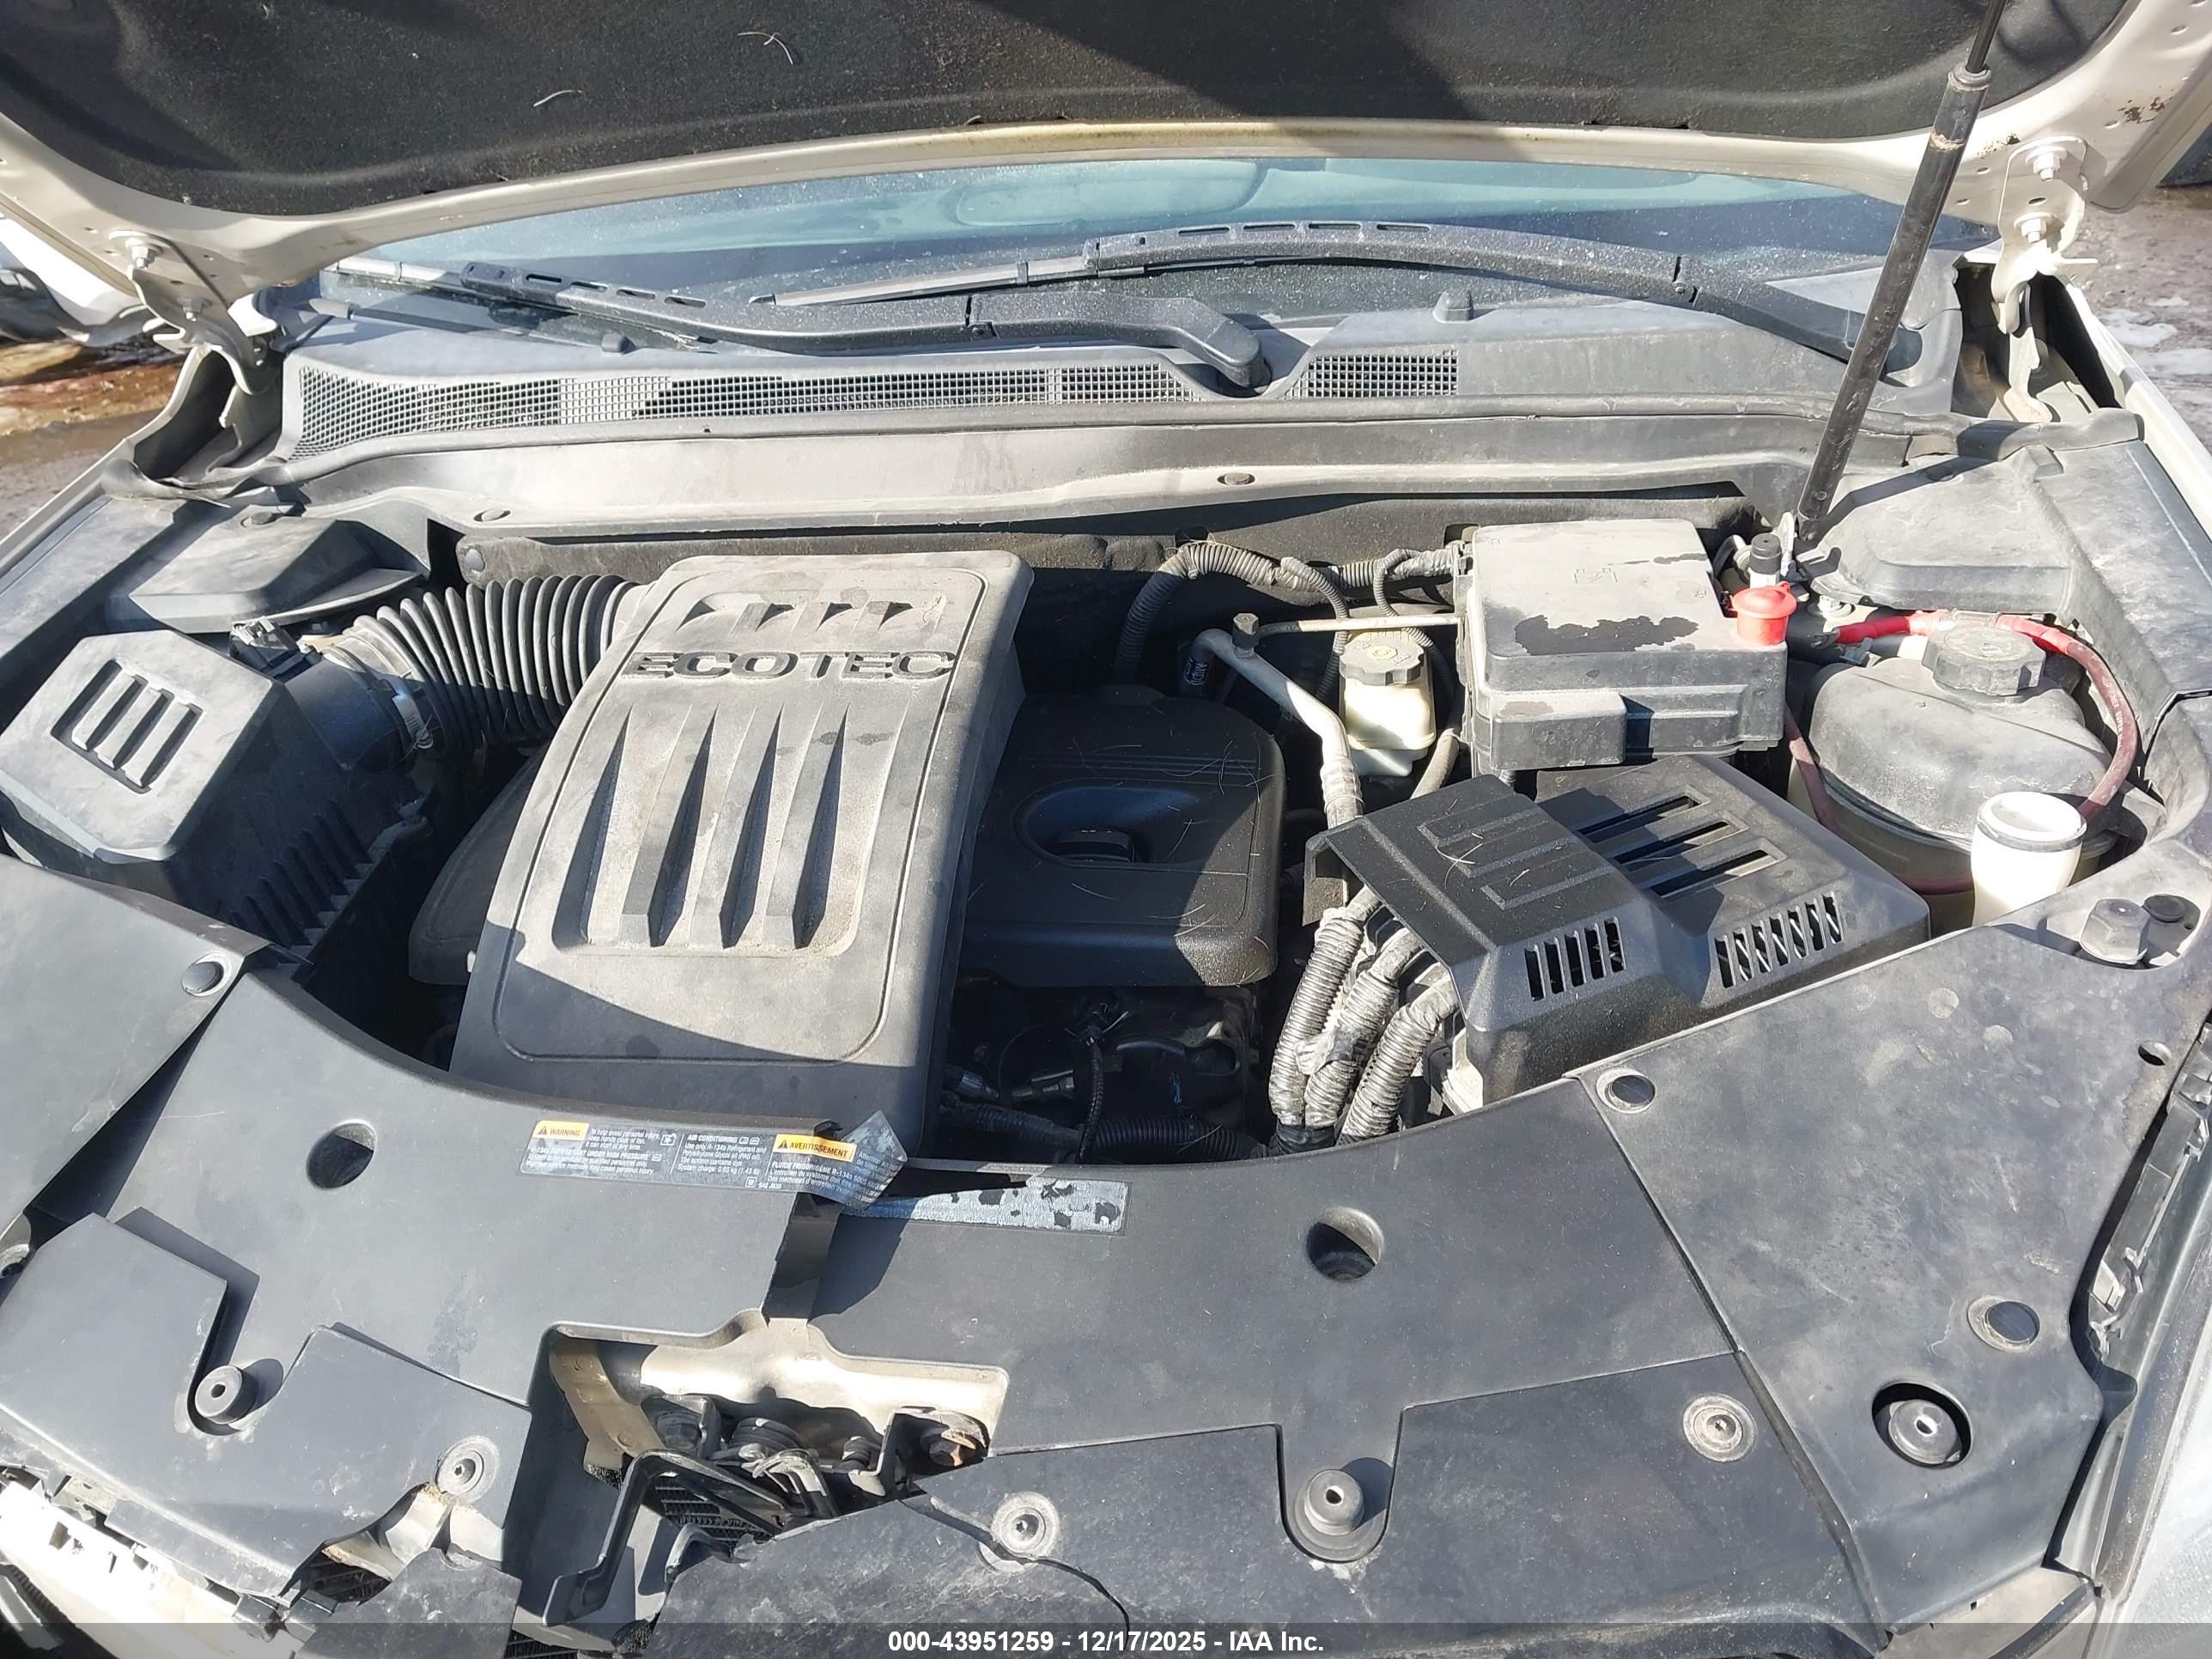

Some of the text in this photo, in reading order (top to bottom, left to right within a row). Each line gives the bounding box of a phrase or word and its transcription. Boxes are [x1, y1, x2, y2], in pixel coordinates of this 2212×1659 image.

[620, 650, 957, 679] ECOTEC
[550, 1127, 581, 1137] WARNING
[698, 1134, 738, 1144] CONDITIONING
[789, 1140, 848, 1158] AVERTISSEMENT
